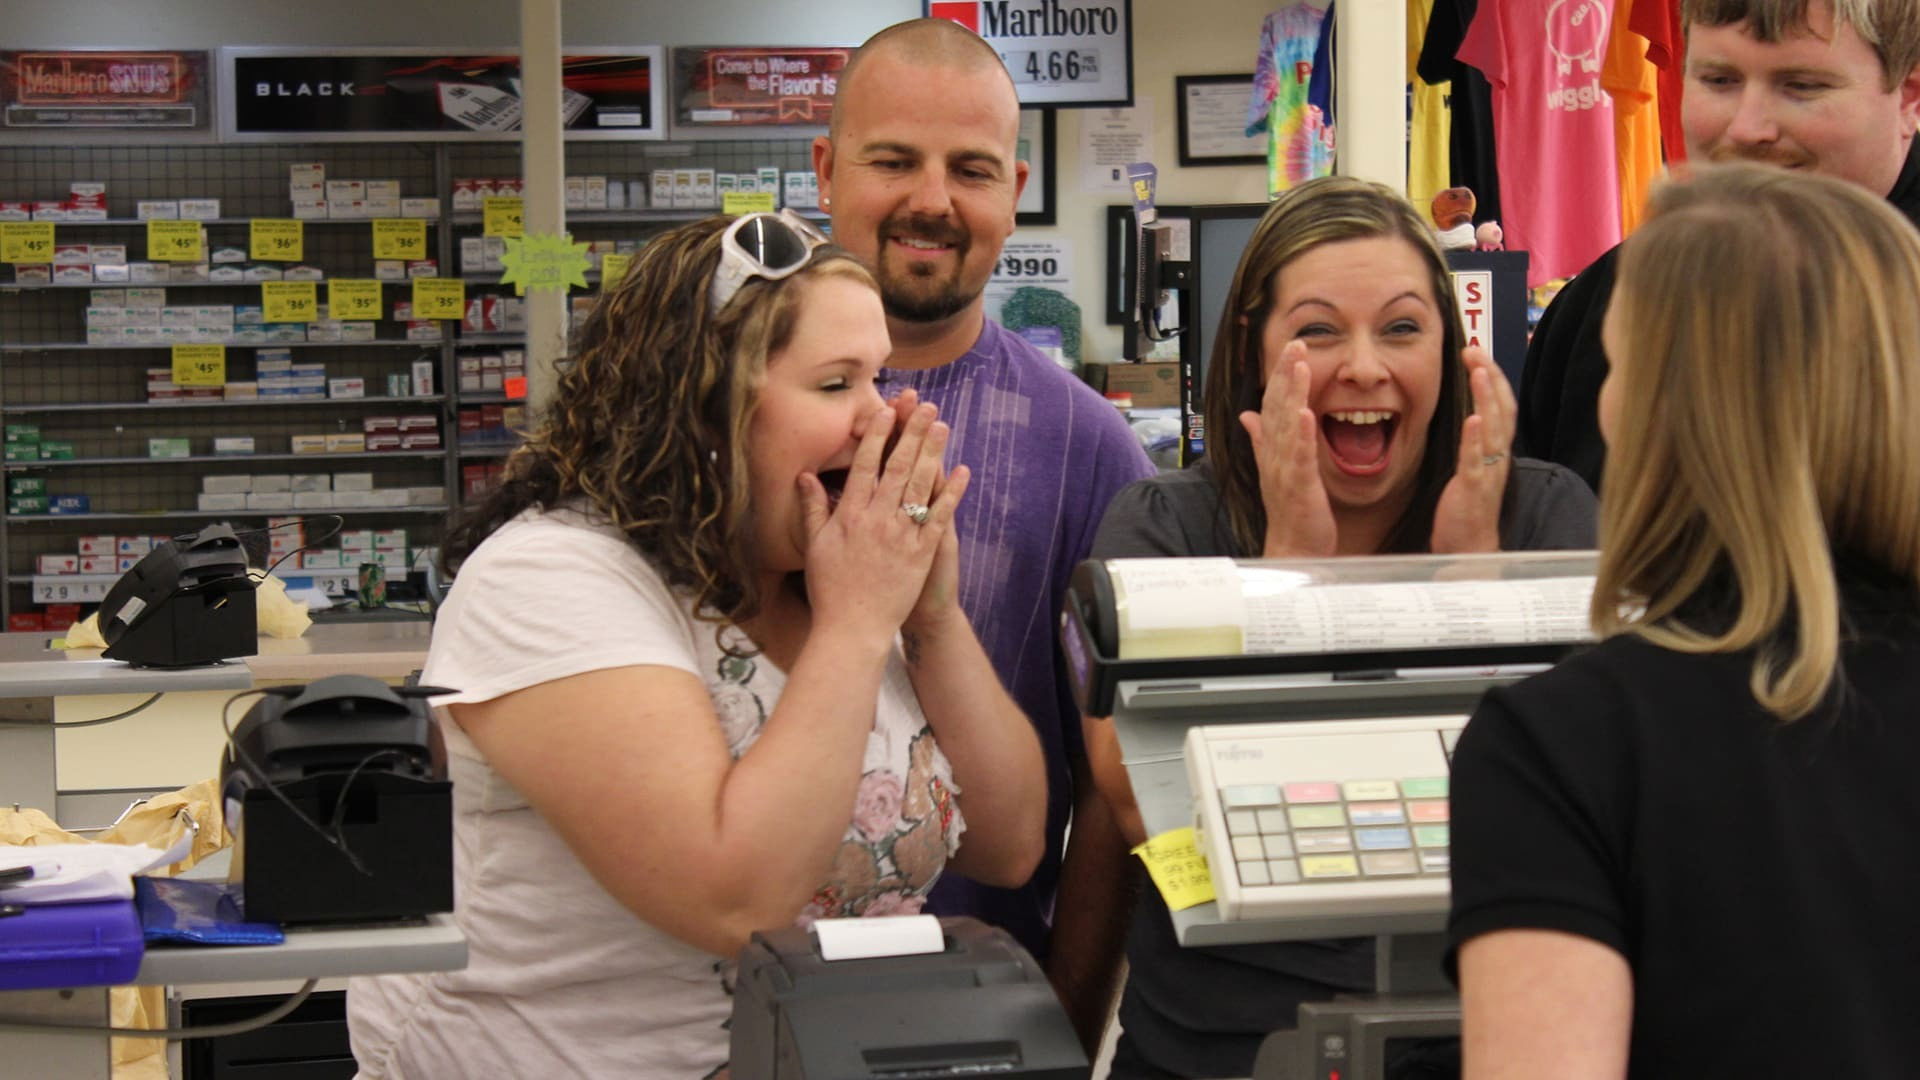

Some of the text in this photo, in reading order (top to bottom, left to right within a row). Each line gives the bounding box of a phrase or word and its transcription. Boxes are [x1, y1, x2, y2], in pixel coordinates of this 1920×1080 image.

[984, 0, 1118, 38] Marlboro
[25, 60, 169, 94] Marlboro SNUS
[716, 57, 810, 75] Come to Where
[1026, 51, 1080, 80] 4.66
[256, 83, 356, 97] BLACK
[747, 73, 838, 96] the Flavor is
